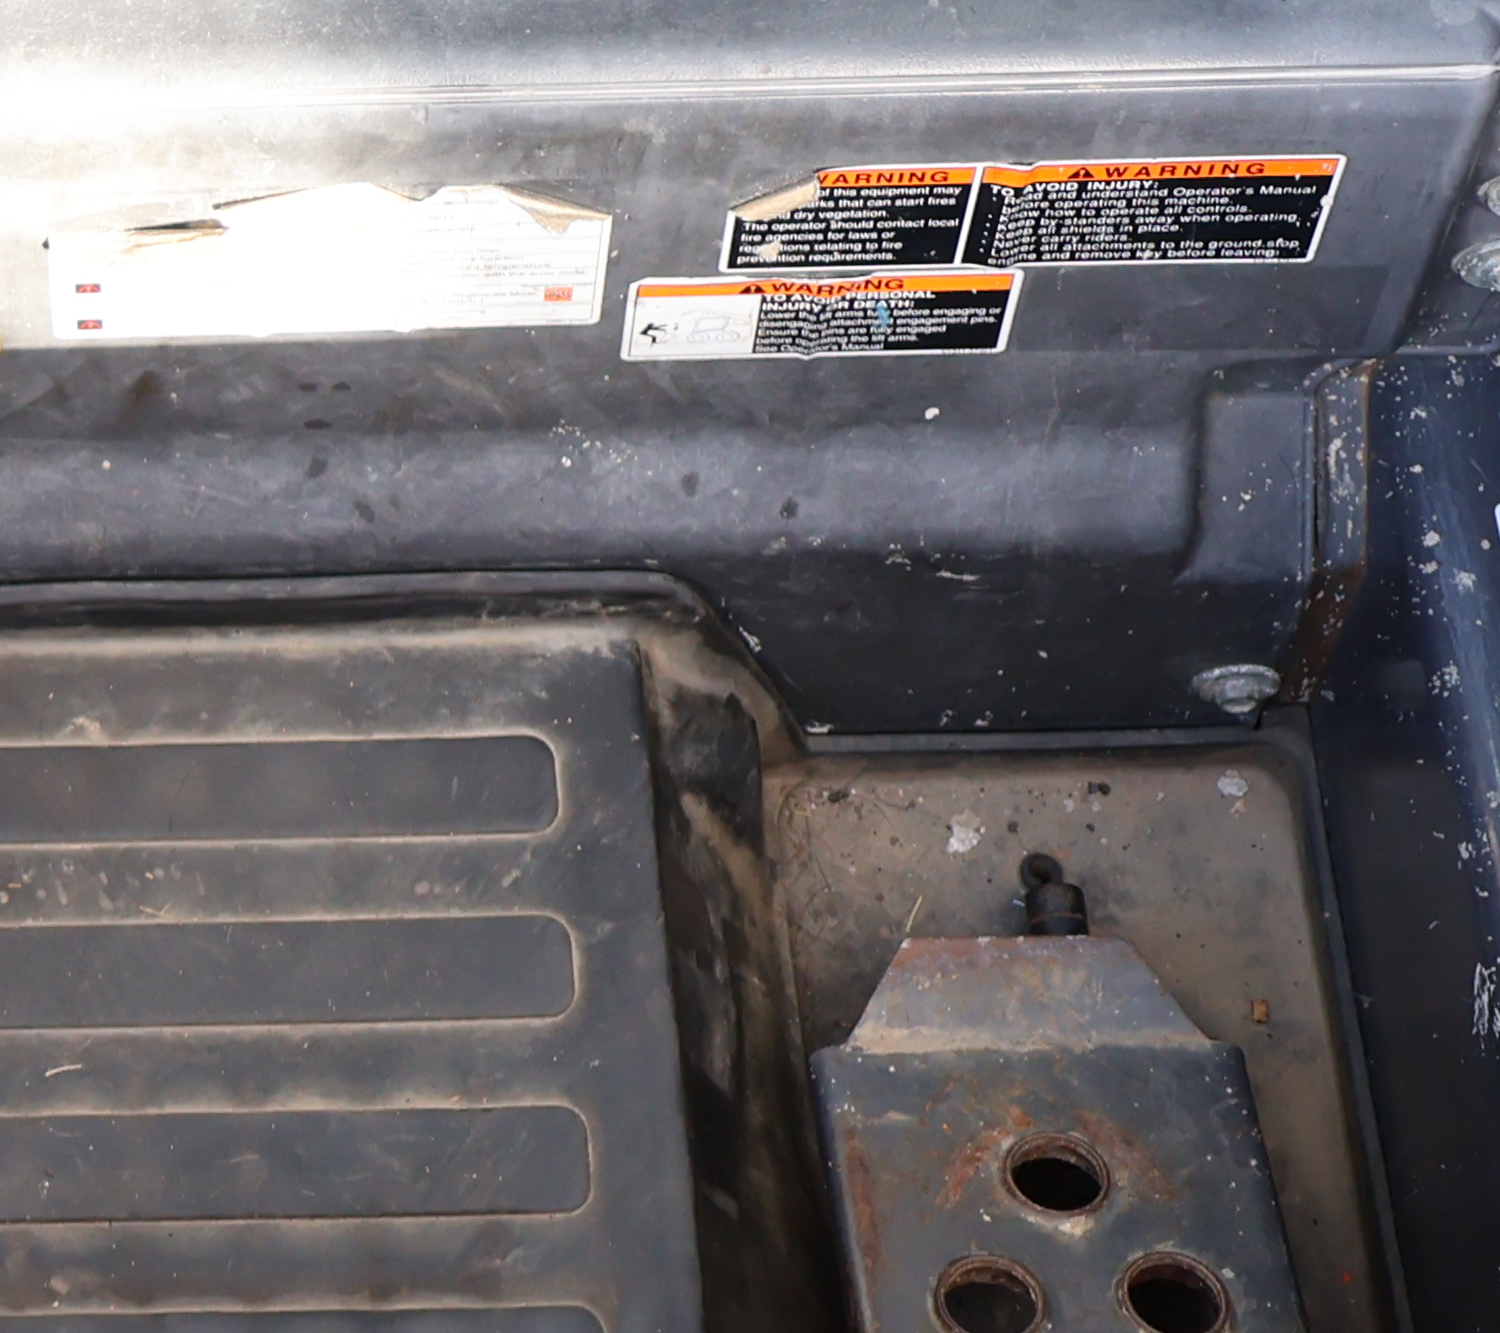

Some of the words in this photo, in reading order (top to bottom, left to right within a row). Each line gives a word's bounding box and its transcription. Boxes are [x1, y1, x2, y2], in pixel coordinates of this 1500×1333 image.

[1103, 162, 1266, 179] WARNING
[832, 187, 857, 196] this
[859, 185, 930, 197] equipment
[931, 185, 962, 196] may
[988, 183, 1017, 196] TO
[1022, 181, 1079, 193] AVOID
[1086, 179, 1160, 190] INJURY:
[1047, 191, 1077, 199] and
[1081, 187, 1169, 198] understand
[1172, 184, 1256, 197] Operator's
[1258, 183, 1317, 195] Manual
[838, 198, 864, 208] that
[866, 198, 892, 207] can
[894, 197, 924, 207] start
[927, 195, 958, 206] fires
[1053, 198, 1127, 209] operating
[1131, 197, 1160, 206] this
[793, 211, 815, 220] dry
[1044, 208, 1077, 217] how
[1080, 207, 1096, 216] to
[1099, 206, 1160, 216] operate
[1163, 205, 1183, 214] all
[744, 222, 768, 231] The
[771, 221, 826, 231] operator
[828, 219, 874, 229] should
[875, 218, 925, 228] contact
[927, 217, 960, 227] local
[1134, 215, 1175, 225] away
[1178, 213, 1221, 222] when
[1037, 225, 1056, 235] all
[1060, 224, 1115, 234] shields
[1118, 224, 1134, 232] in
[740, 233, 762, 241] fire
[764, 231, 824, 242] agencies
[826, 230, 845, 239] for
[847, 230, 878, 240] laws
[880, 230, 895, 238] or
[1040, 235, 1080, 244] carry
[812, 241, 862, 252] relating
[865, 241, 878, 249] to
[880, 240, 903, 249] fire
[1039, 243, 1059, 251] all
[1062, 241, 1156, 251] attachments
[1159, 240, 1176, 249] to
[1179, 240, 1204, 248] the
[1074, 251, 1131, 259] remove
[1166, 249, 1216, 257] before
[770, 277, 905, 295] WARNING
[764, 293, 787, 301] TO
[844, 289, 938, 301] PERSONAL
[825, 301, 849, 310] OR
